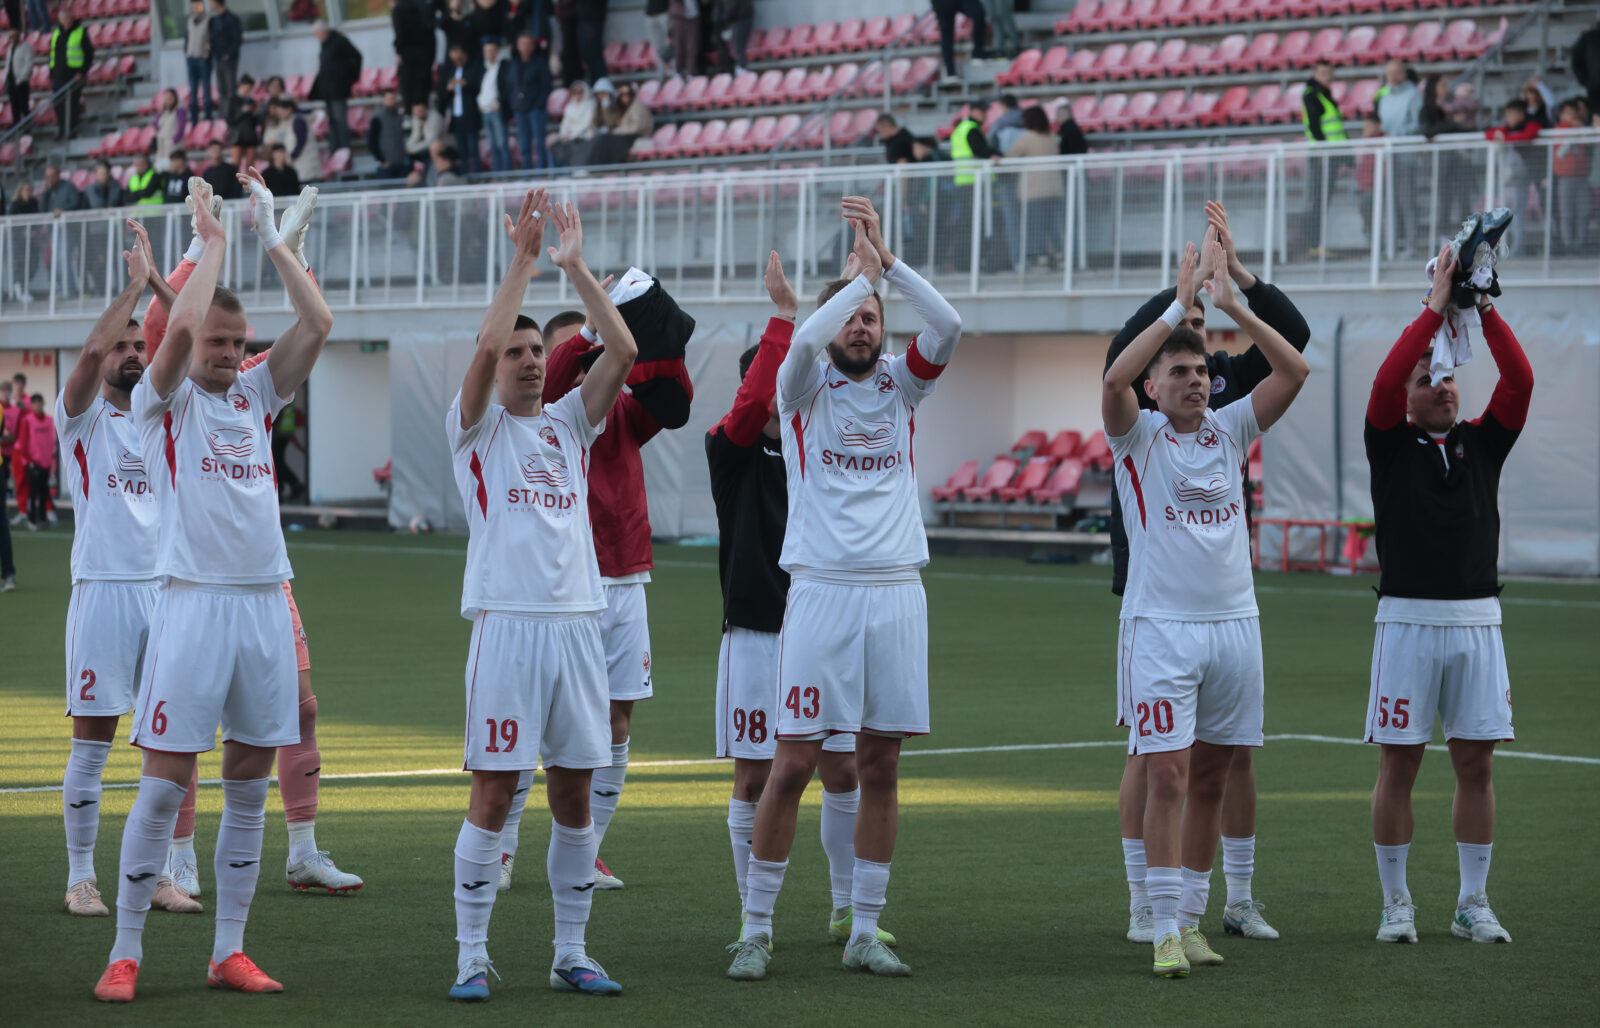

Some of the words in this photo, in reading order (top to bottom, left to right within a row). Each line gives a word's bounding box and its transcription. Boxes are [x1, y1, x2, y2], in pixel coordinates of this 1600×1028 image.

[80, 669, 96, 701] 2
[785, 686, 820, 719] 43
[152, 700, 168, 736] 6
[733, 707, 767, 744] 98
[1137, 700, 1174, 737] 20
[1379, 696, 1410, 729] 55
[485, 718, 518, 753] 19
